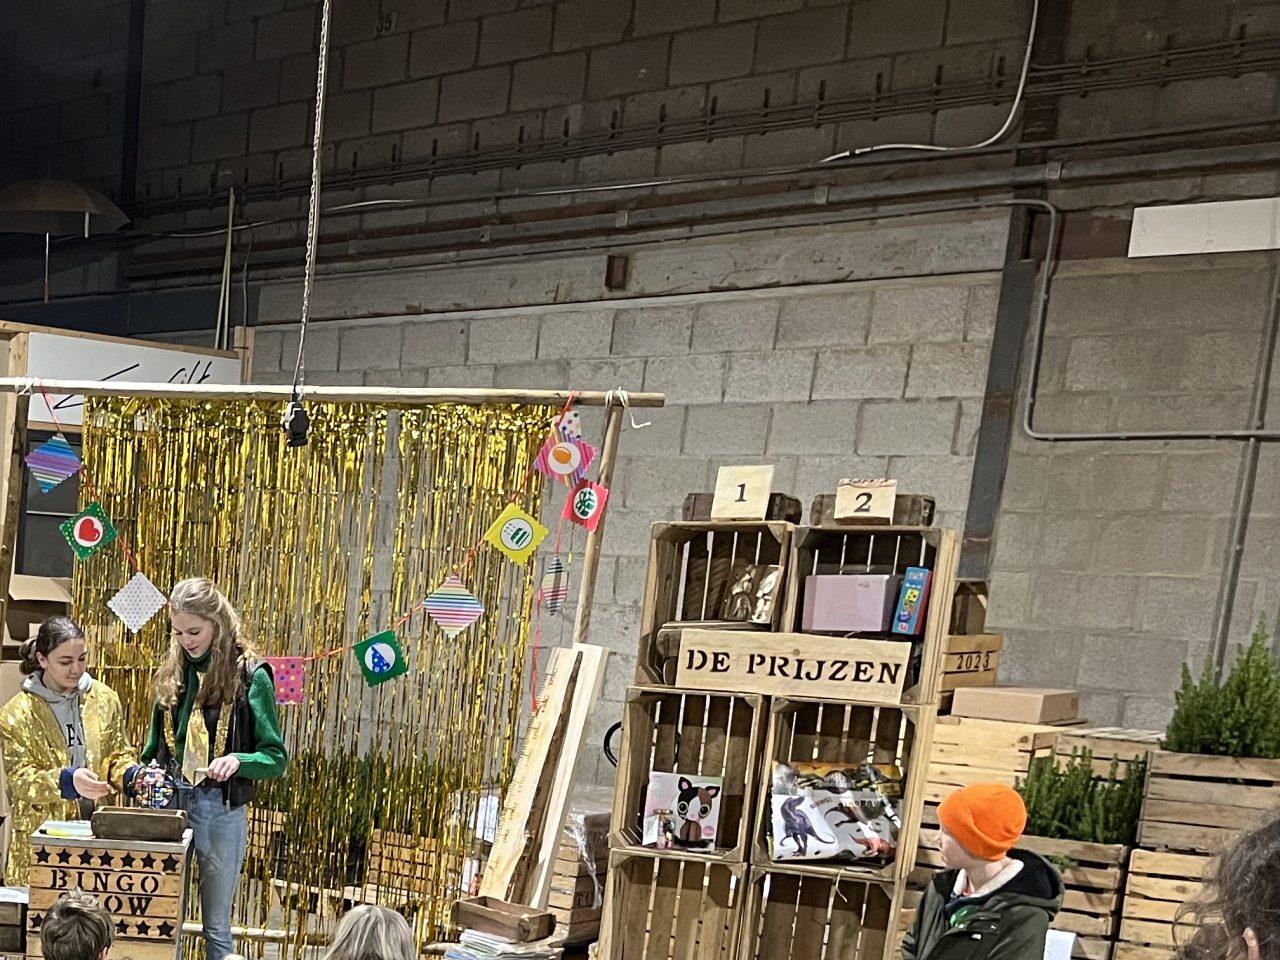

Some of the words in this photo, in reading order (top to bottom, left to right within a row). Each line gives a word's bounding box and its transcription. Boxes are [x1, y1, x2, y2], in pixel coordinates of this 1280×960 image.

[734, 483, 747, 502] 1
[853, 492, 874, 513] 2
[686, 649, 731, 673] DE
[747, 654, 903, 684] PRIJZEN
[956, 653, 990, 670] 2023
[50, 869, 159, 894] BINGO
